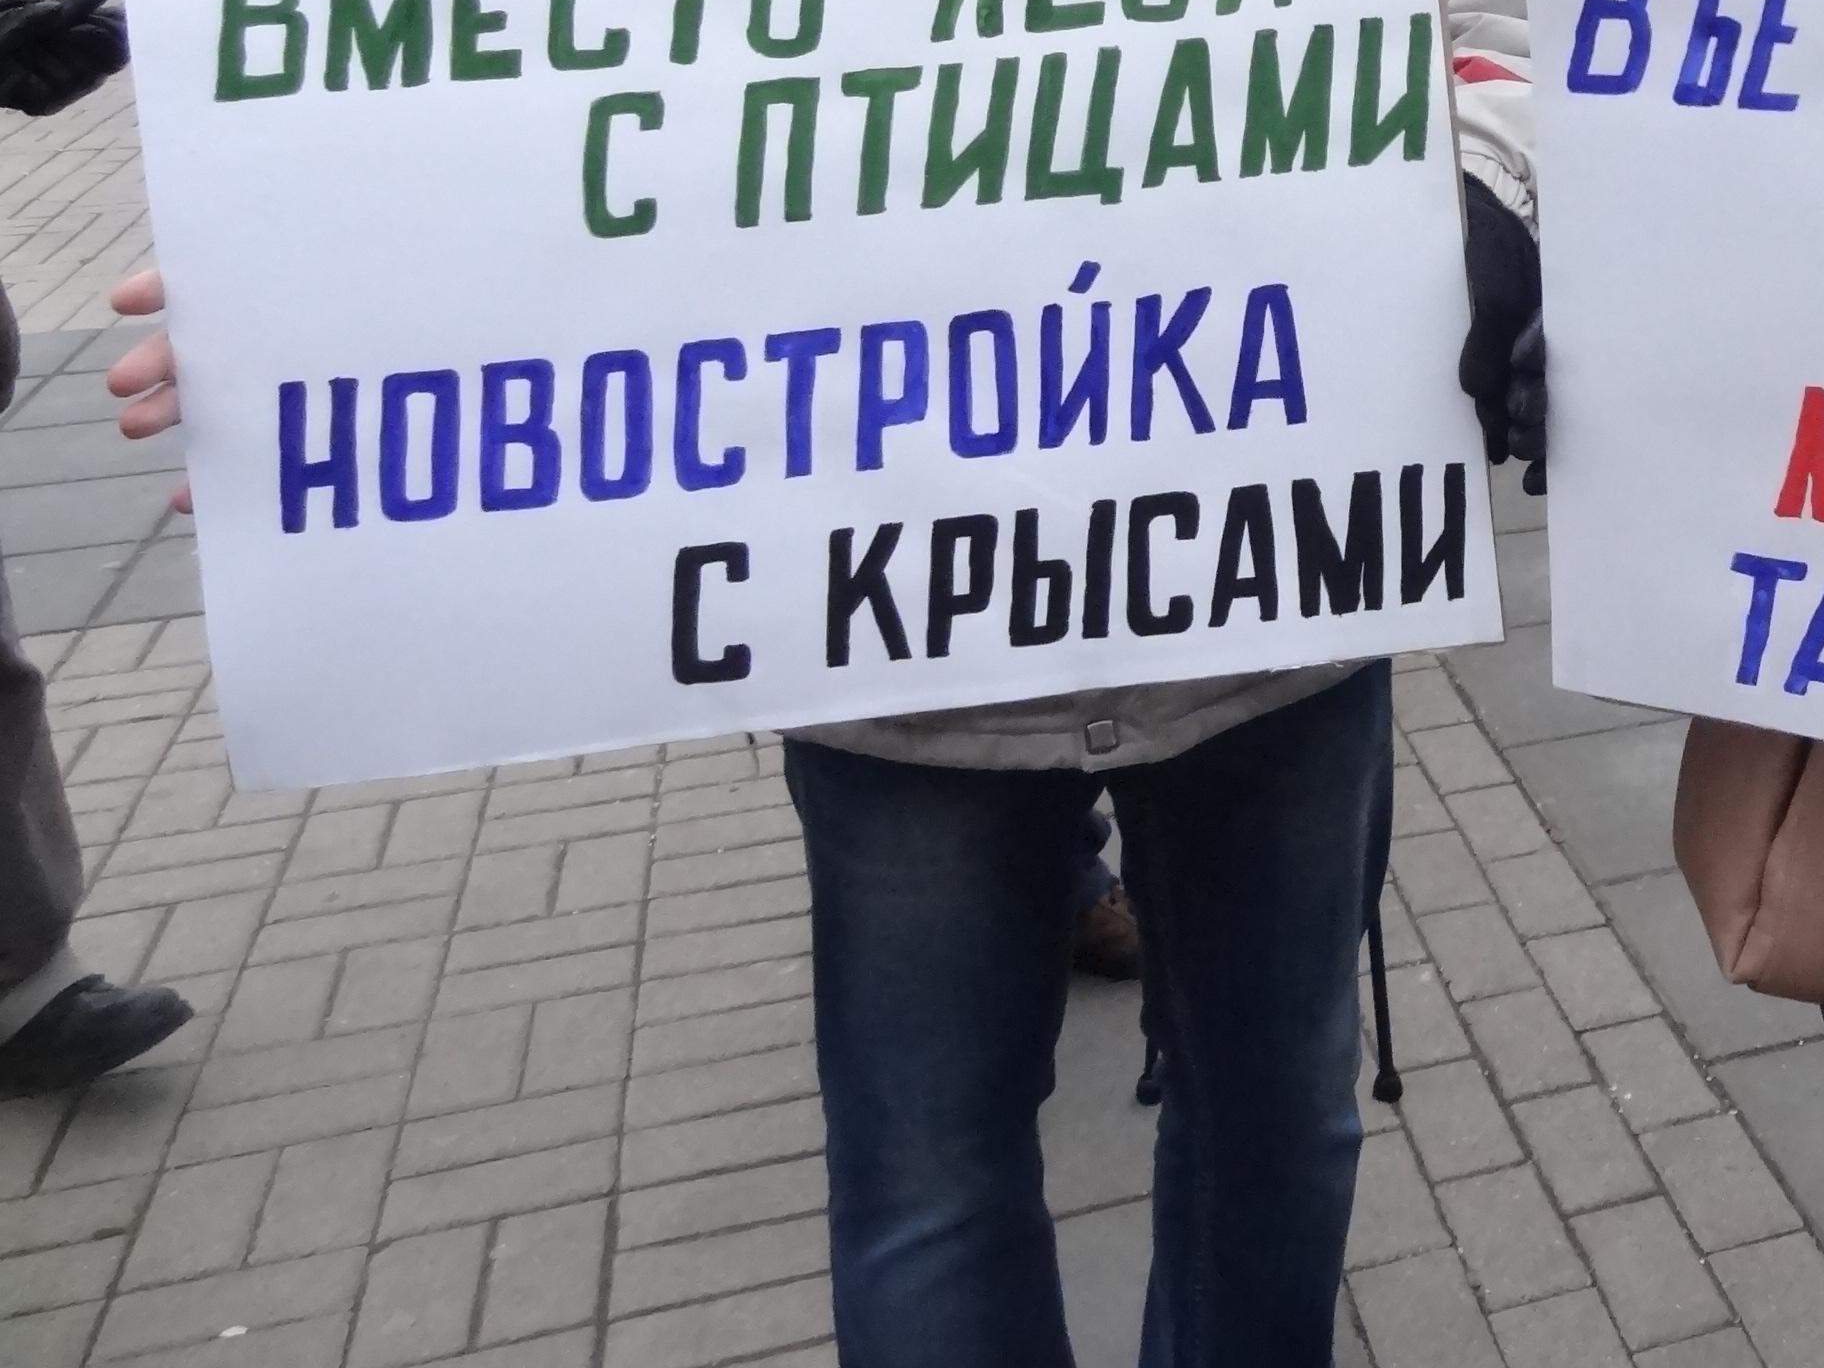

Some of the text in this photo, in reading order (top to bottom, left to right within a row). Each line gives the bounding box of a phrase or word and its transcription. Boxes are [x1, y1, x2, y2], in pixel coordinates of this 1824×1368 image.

[582, 12, 1433, 238] С ПТИЦАМИ
[278, 261, 1307, 534] НОВОСТРОЙКА
[671, 462, 1467, 685] С КРЫСАМИ
